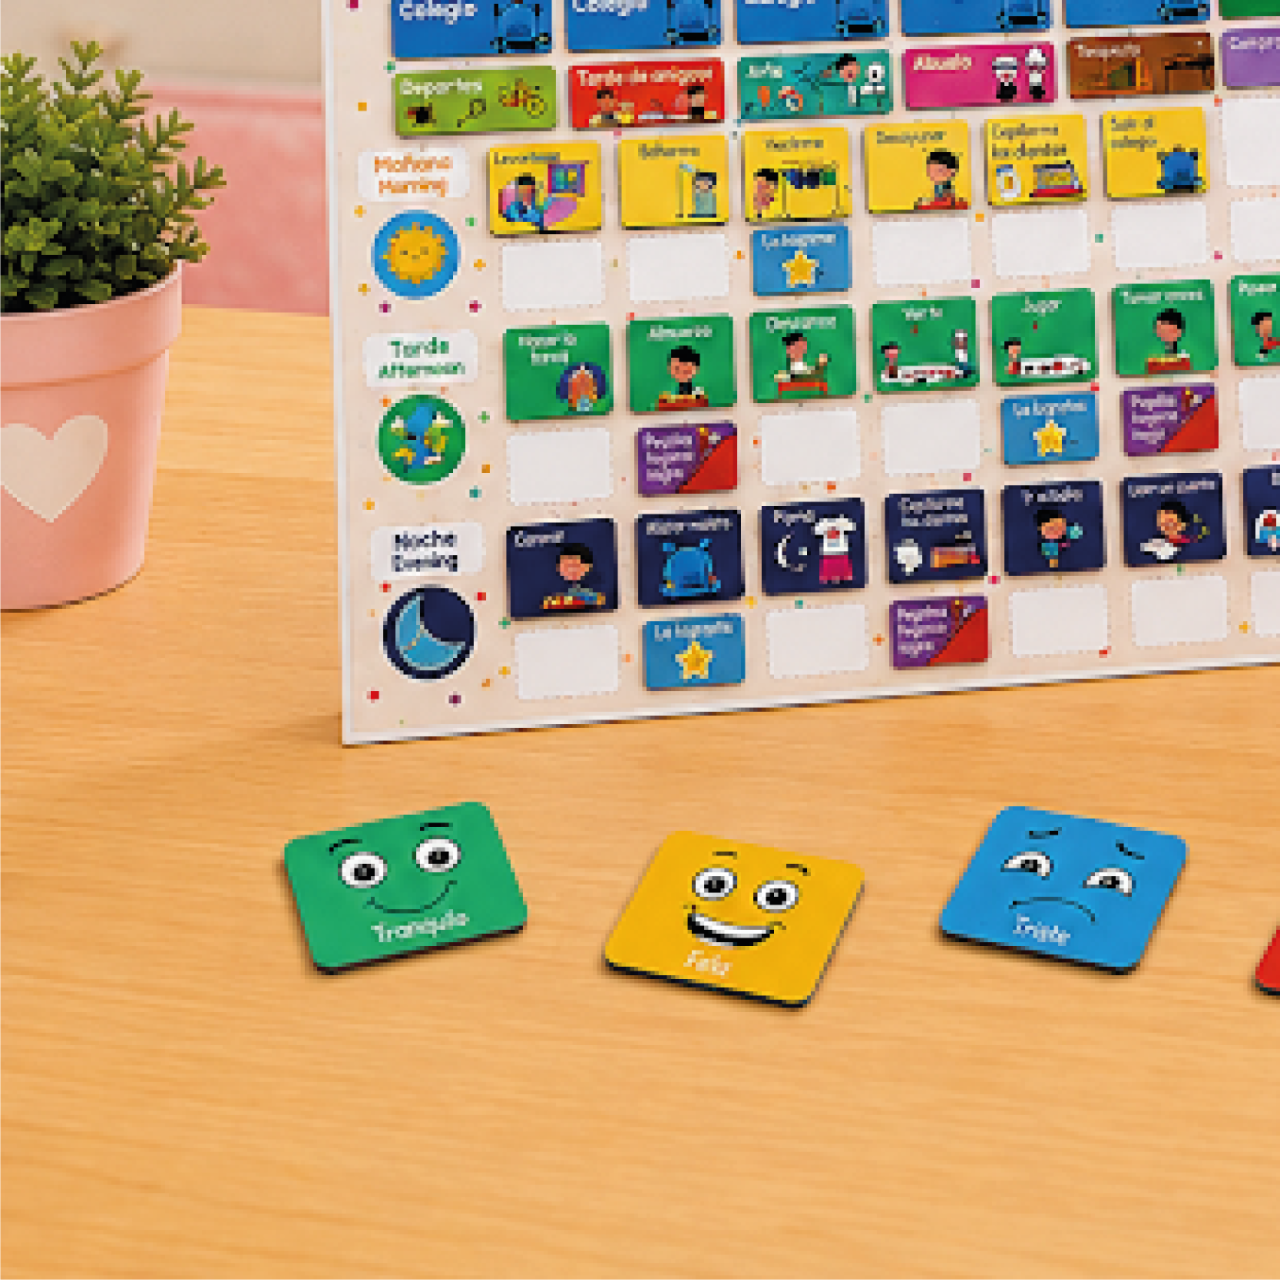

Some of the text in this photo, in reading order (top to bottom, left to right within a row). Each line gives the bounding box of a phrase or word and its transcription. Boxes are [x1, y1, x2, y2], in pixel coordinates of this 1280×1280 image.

[399, 77, 483, 99] Deportes
[388, 337, 450, 360] Tarde
[393, 529, 457, 550] Noche
[391, 553, 459, 573] Evening
[370, 909, 470, 943] Tranquilo
[1012, 914, 1072, 947] Triste
[684, 948, 731, 977] Feliz
